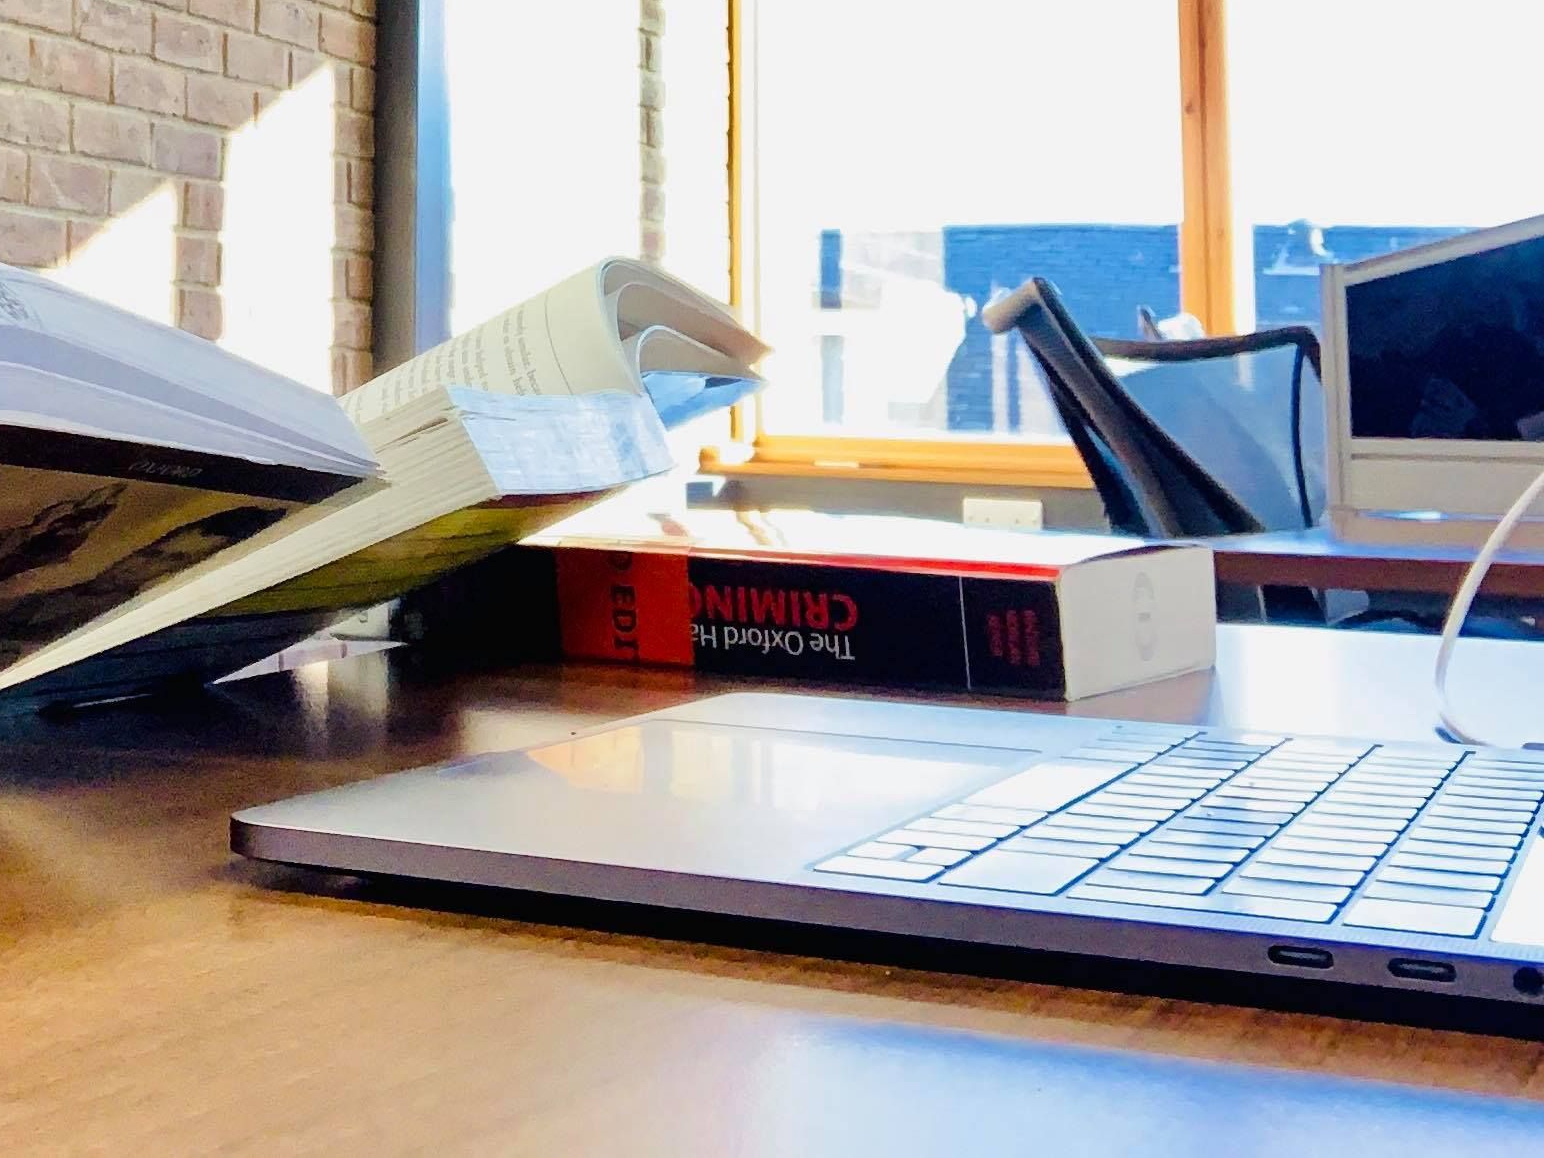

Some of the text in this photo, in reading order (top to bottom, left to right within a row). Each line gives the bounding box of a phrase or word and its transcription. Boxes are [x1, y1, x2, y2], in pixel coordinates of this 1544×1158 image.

[612, 585, 639, 660] EDI
[724, 625, 804, 655] Oxford
[809, 632, 856, 660] The
